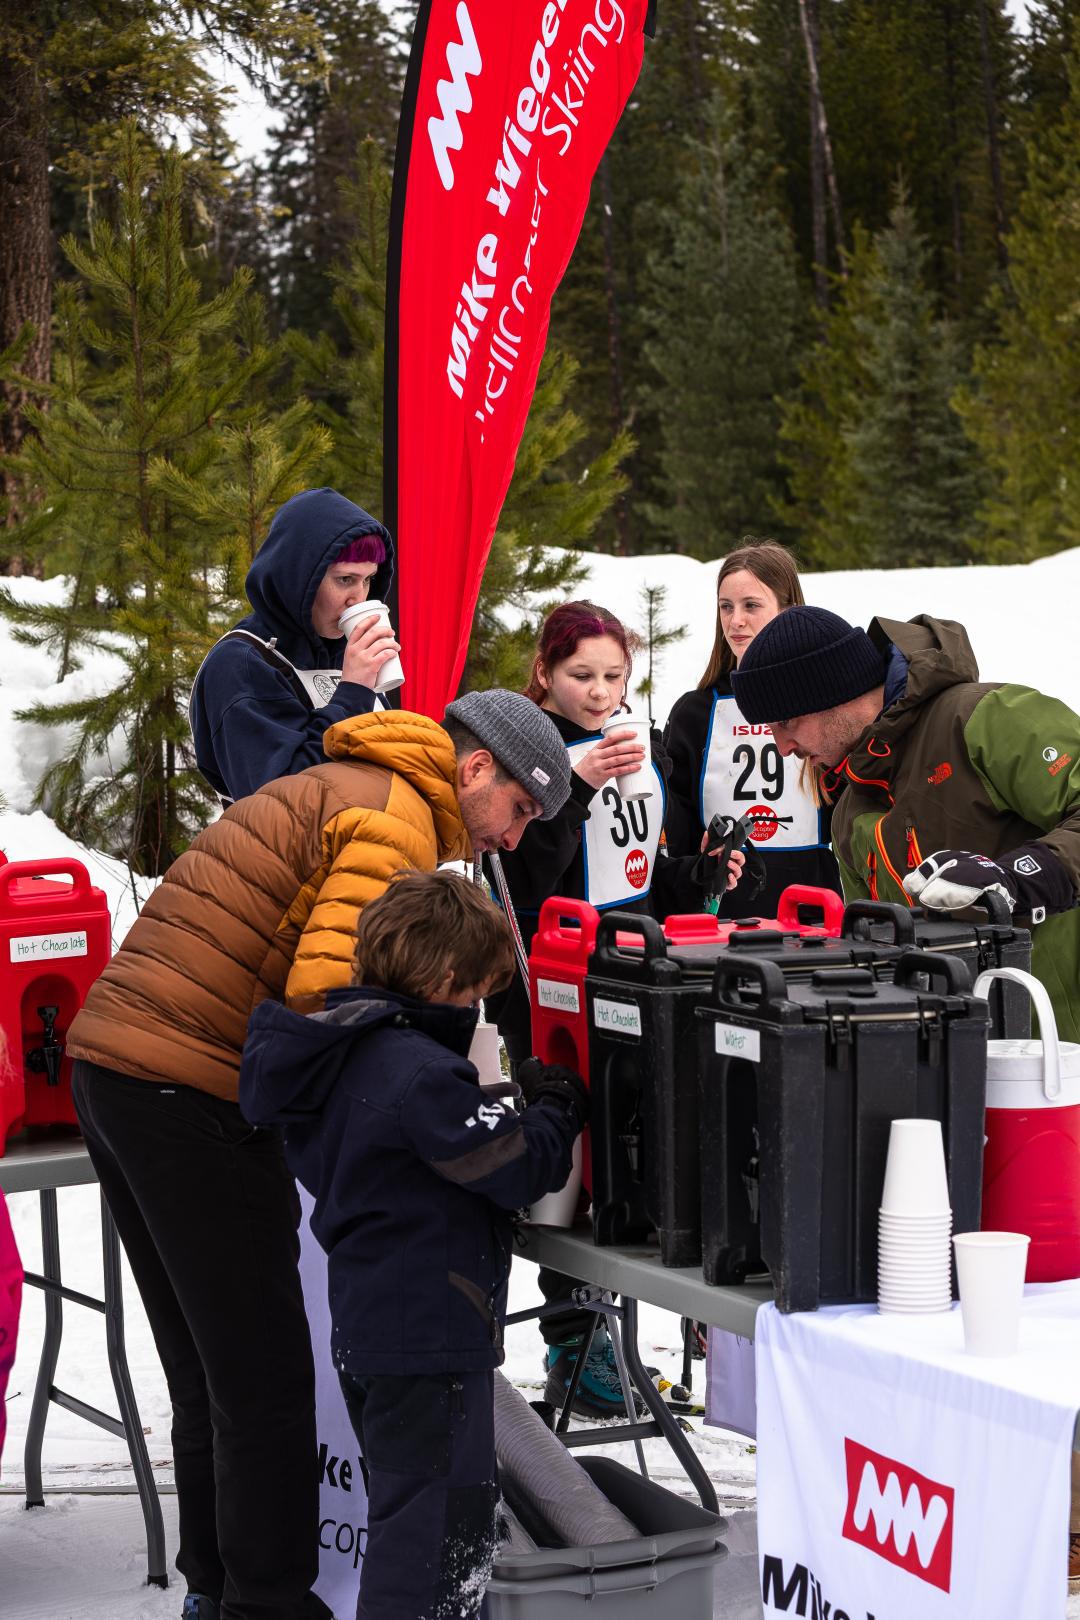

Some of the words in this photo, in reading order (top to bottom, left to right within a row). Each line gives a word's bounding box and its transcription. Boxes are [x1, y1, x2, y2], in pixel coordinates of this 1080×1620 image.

[541, 0, 625, 156] Skiing
[447, 233, 499, 399] Mike
[732, 725, 773, 736] ISUZ
[732, 743, 784, 801] 29
[601, 786, 649, 848] 30
[17, 942, 38, 955] Hot
[540, 985, 552, 1000] Hot
[598, 1005, 609, 1022] Hot
[612, 1009, 639, 1027] Chocolate
[724, 1030, 747, 1049] Water
[763, 1554, 851, 1620] Mik
